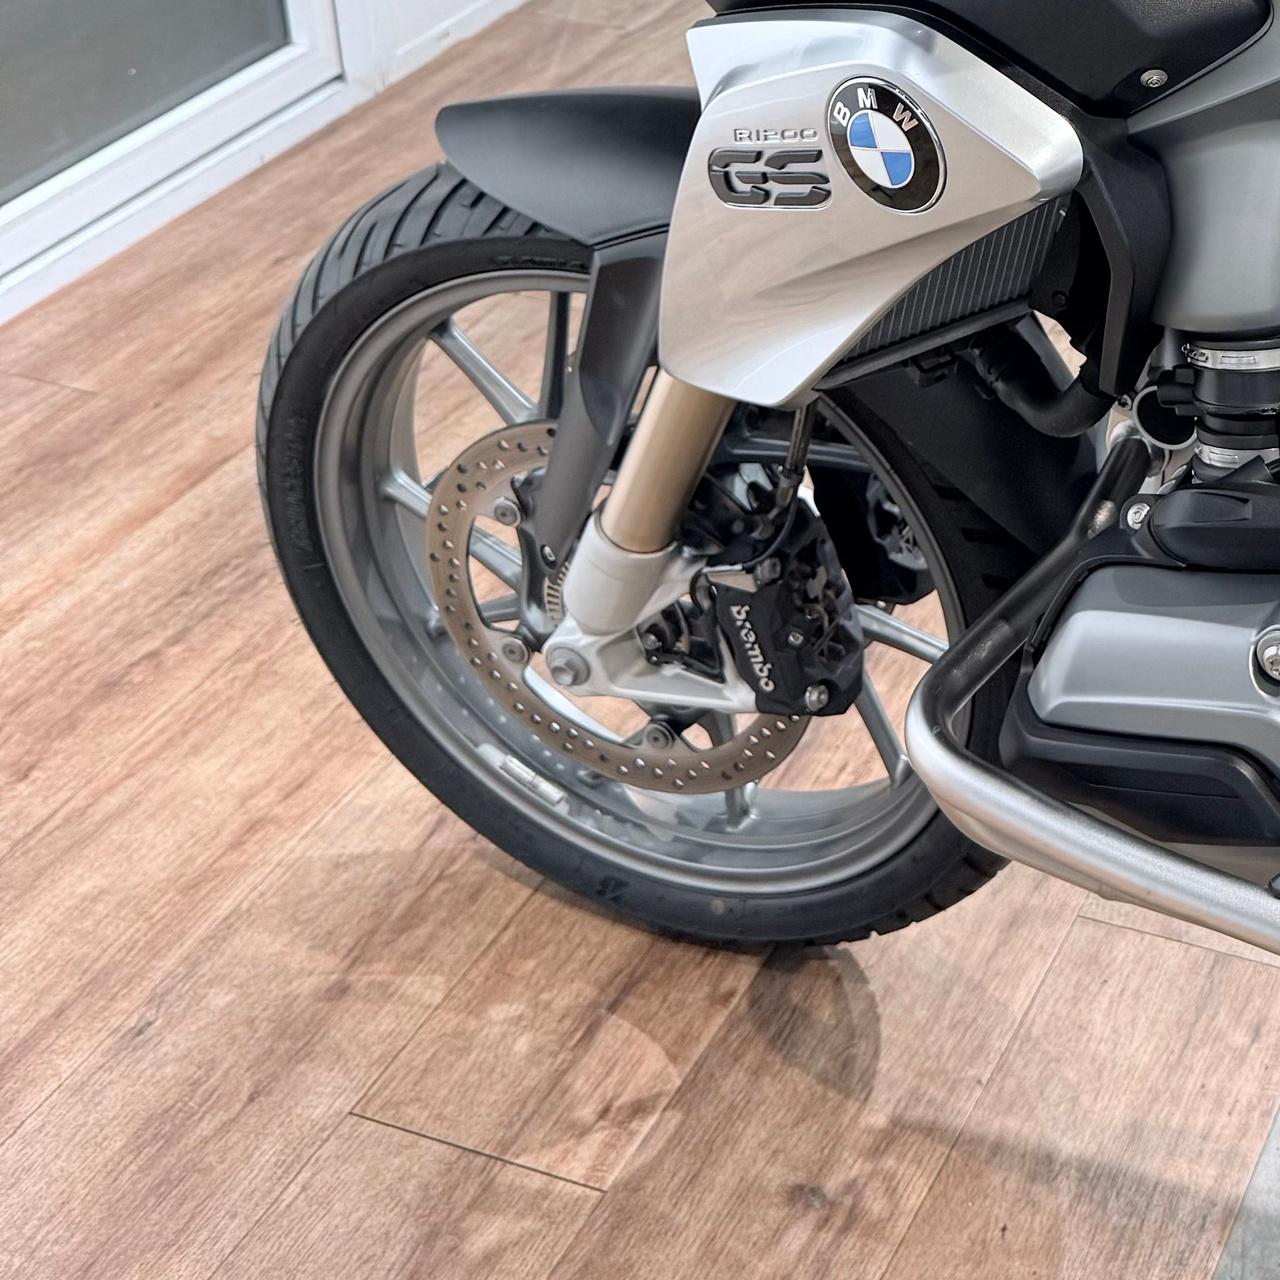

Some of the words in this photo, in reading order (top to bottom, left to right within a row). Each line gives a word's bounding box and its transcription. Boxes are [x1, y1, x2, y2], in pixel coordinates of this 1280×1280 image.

[733, 128, 819, 143] R1200
[833, 87, 919, 132] BMW
[708, 147, 832, 209] GS
[730, 605, 775, 692] brembo
